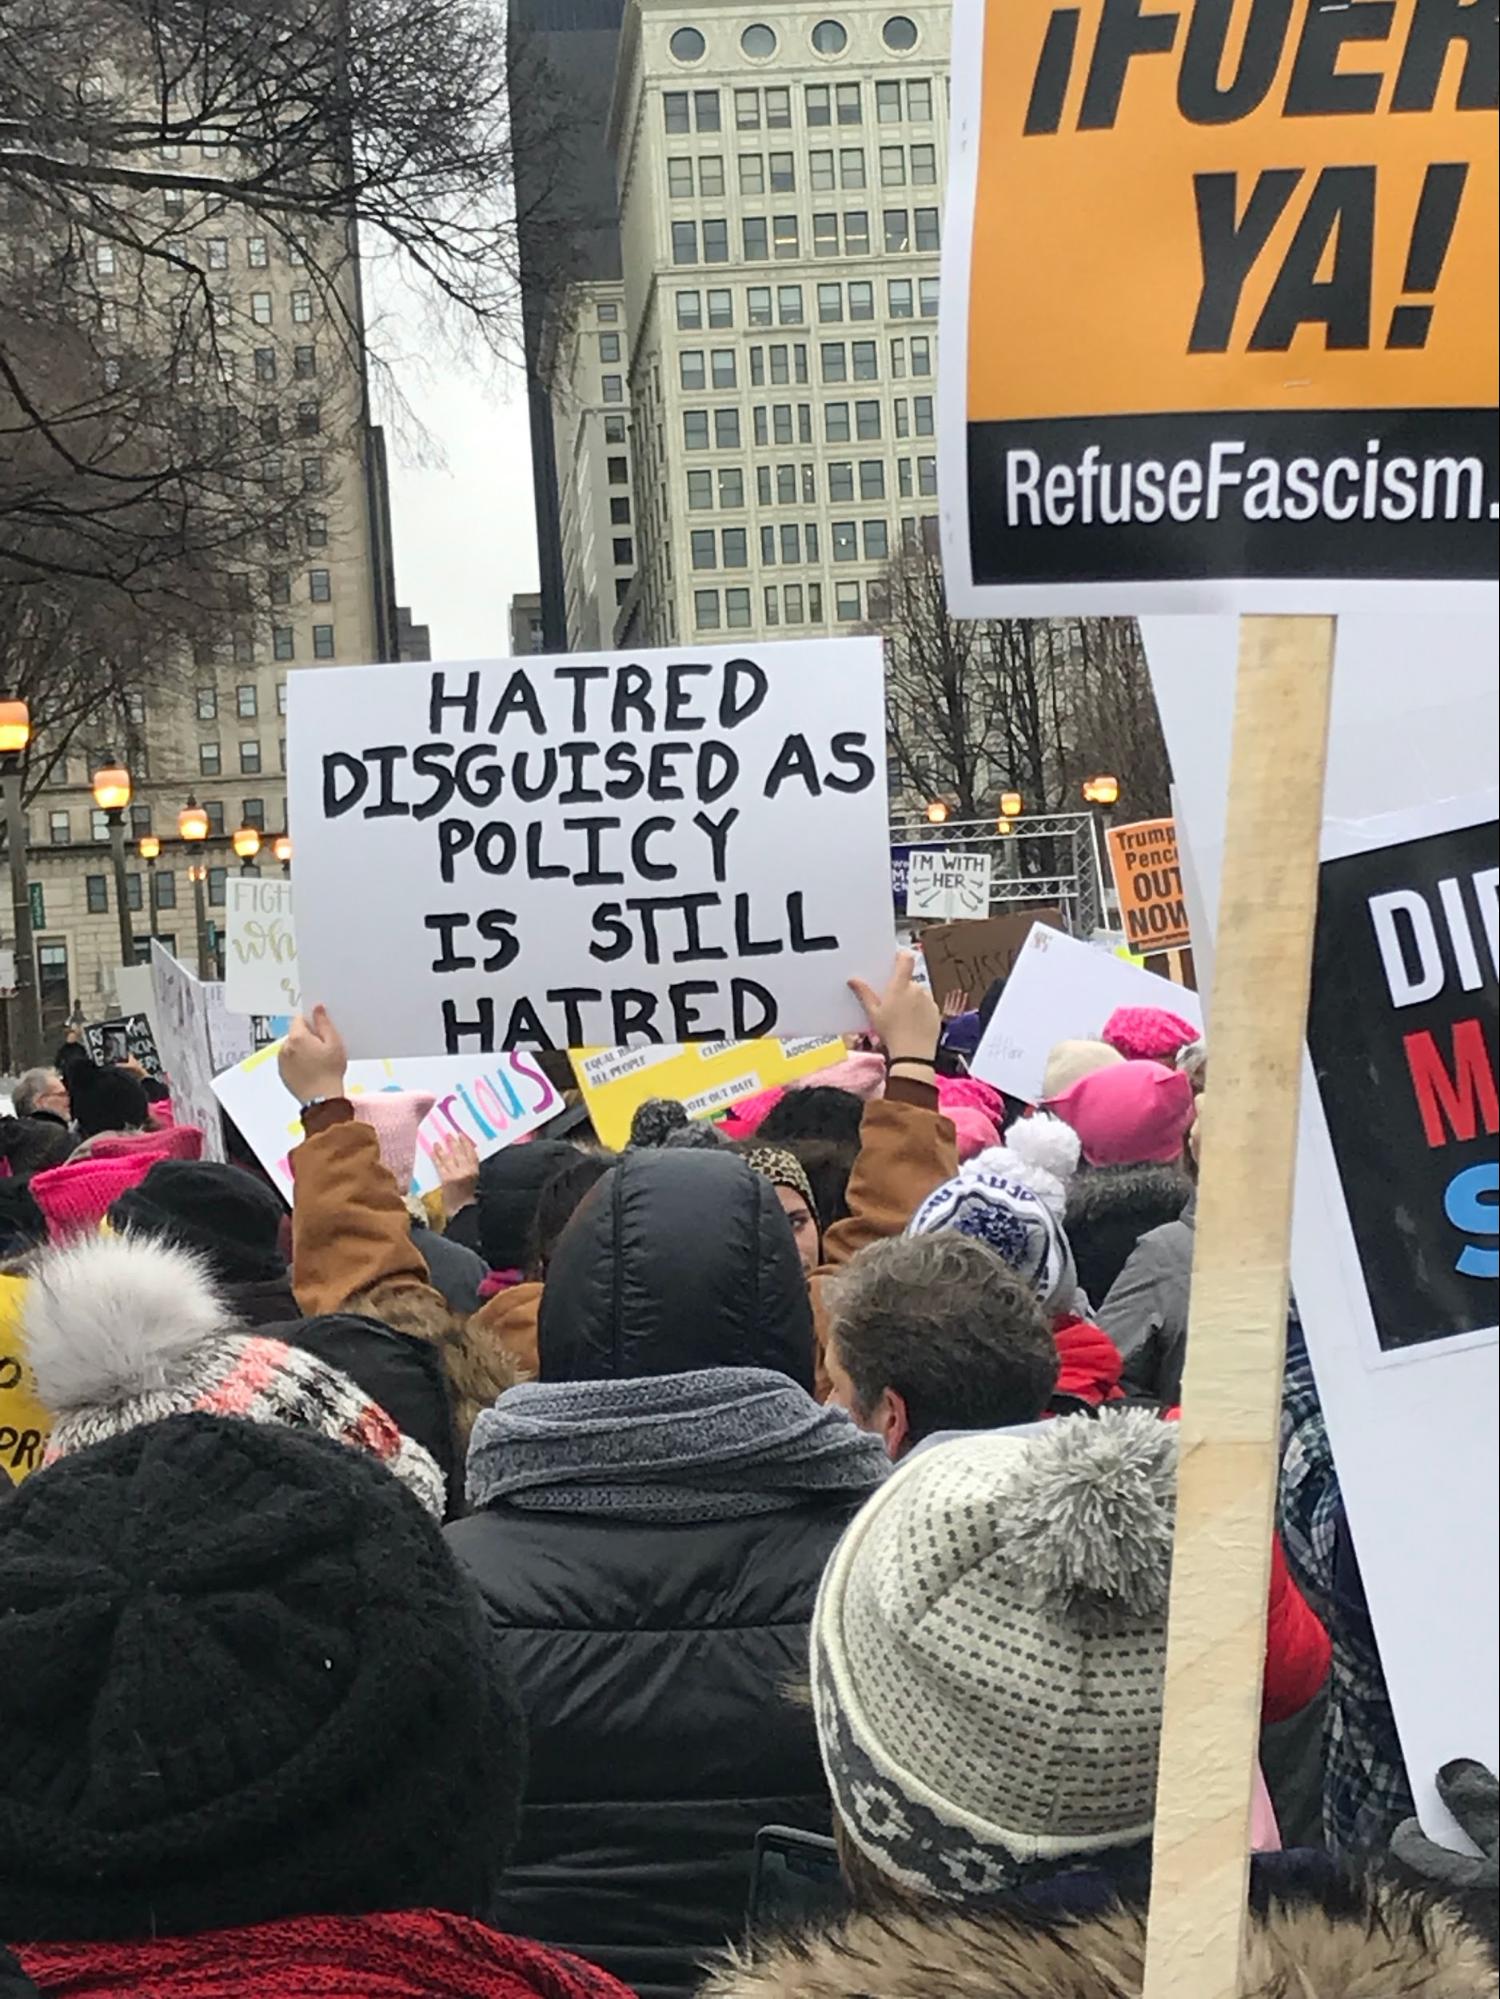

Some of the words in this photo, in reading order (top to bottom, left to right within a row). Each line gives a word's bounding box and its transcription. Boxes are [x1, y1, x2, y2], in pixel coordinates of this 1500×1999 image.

[1187, 163, 1469, 354] YA!
[430, 659, 767, 734] HATRED
[323, 742, 738, 820] DISGUISED
[764, 733, 874, 797] AS
[439, 808, 738, 885] POLICY
[933, 873, 966, 889] HER
[942, 856, 984, 872] WITH
[1133, 867, 1183, 902] OUT
[425, 909, 519, 972] IS
[590, 891, 838, 964] STILL
[442, 978, 777, 1054] HATRED
[413, 1050, 554, 1170] urious
